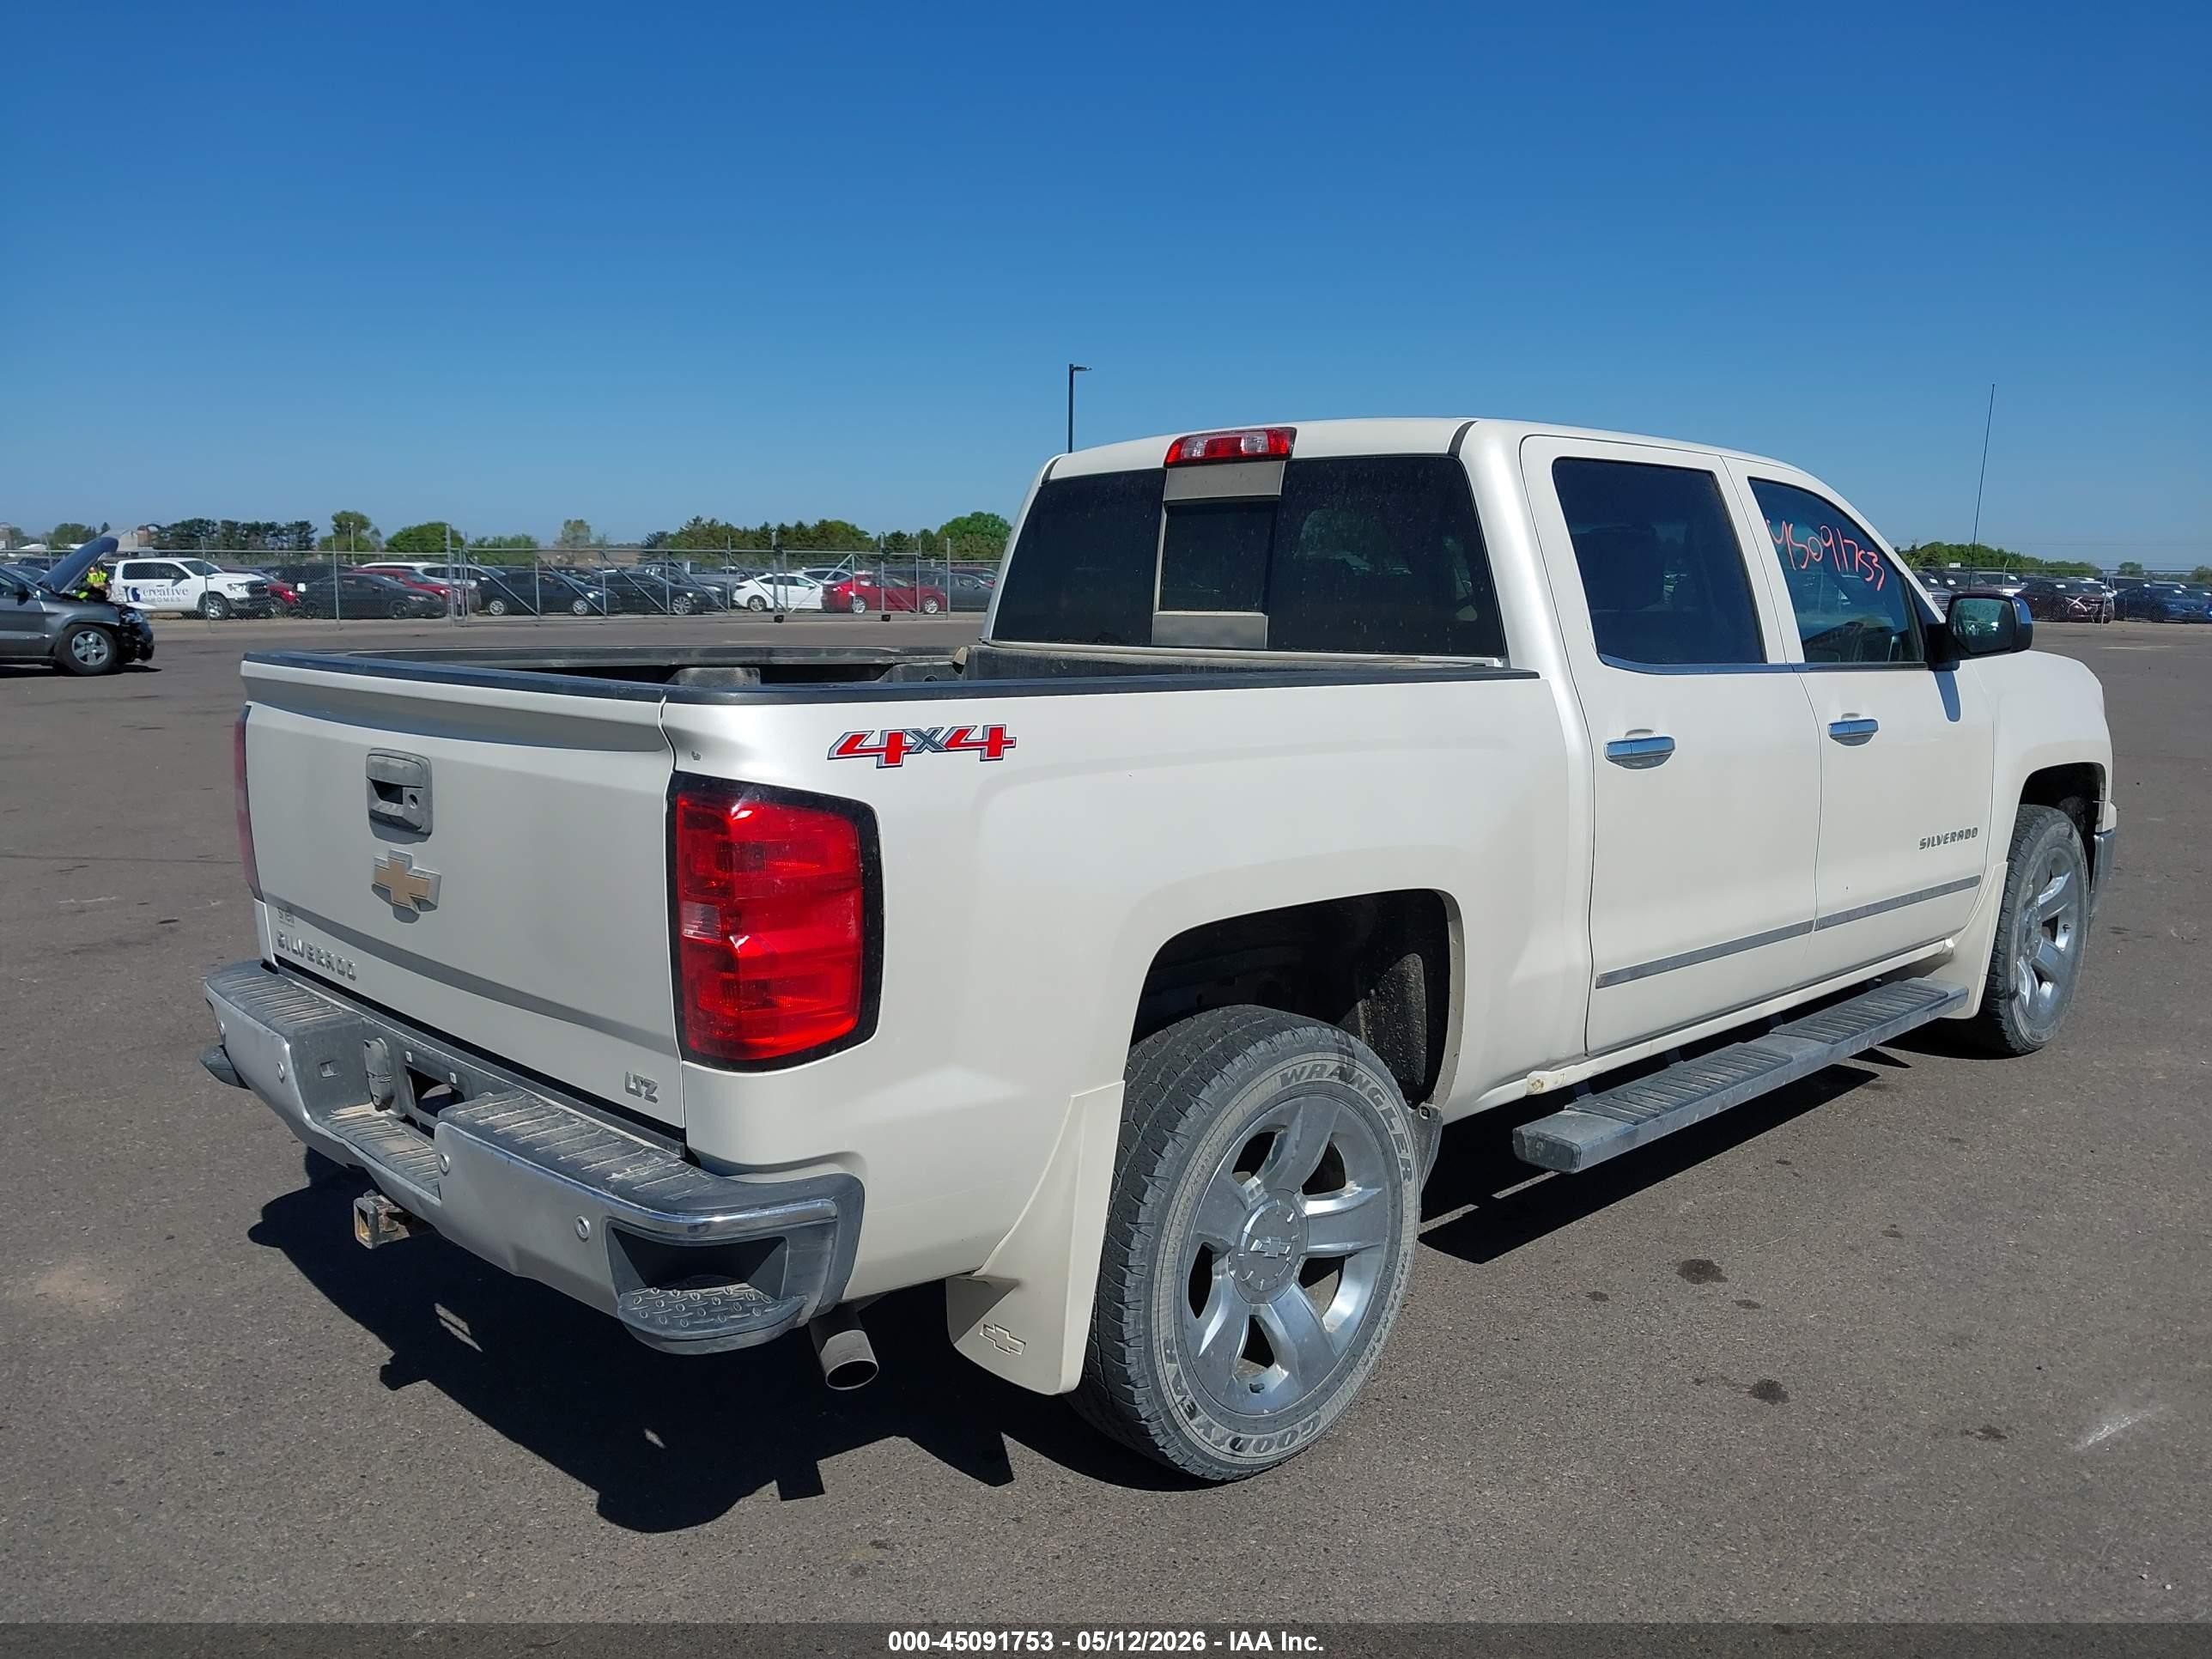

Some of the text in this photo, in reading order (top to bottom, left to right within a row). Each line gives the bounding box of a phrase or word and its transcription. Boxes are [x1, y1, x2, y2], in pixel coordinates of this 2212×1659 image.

[1765, 519, 1886, 592] 45091753
[143, 586, 189, 597] creative
[1918, 826, 1978, 851] SILVERADO
[276, 929, 356, 981] SILVERADO
[624, 1072, 659, 1104] LTZ
[1279, 1062, 1414, 1182] WRANGLER
[1163, 1338, 1322, 1455] GOODYEAR
